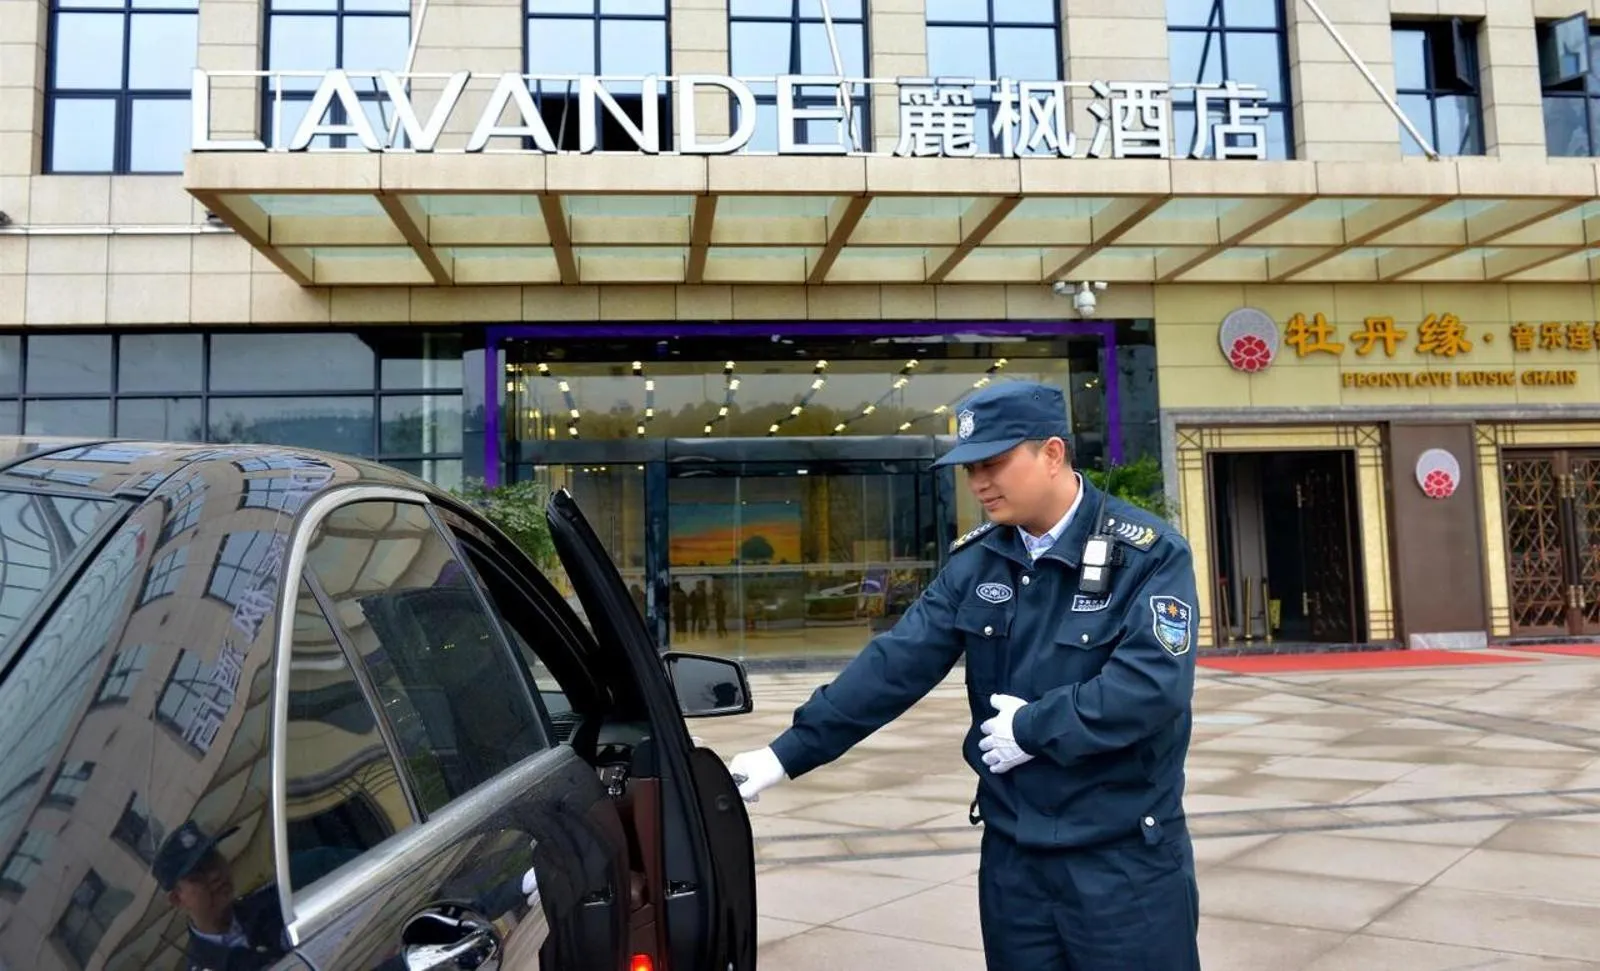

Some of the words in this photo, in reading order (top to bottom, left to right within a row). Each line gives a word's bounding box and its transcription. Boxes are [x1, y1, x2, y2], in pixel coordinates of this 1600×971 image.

[191, 69, 847, 155] LAVANDE
[892, 76, 1270, 160] 麗枫酒店
[1342, 371, 1453, 388] PEONYLOVE
[1456, 371, 1515, 387] MUSIC
[1521, 370, 1577, 386] CHAIN
